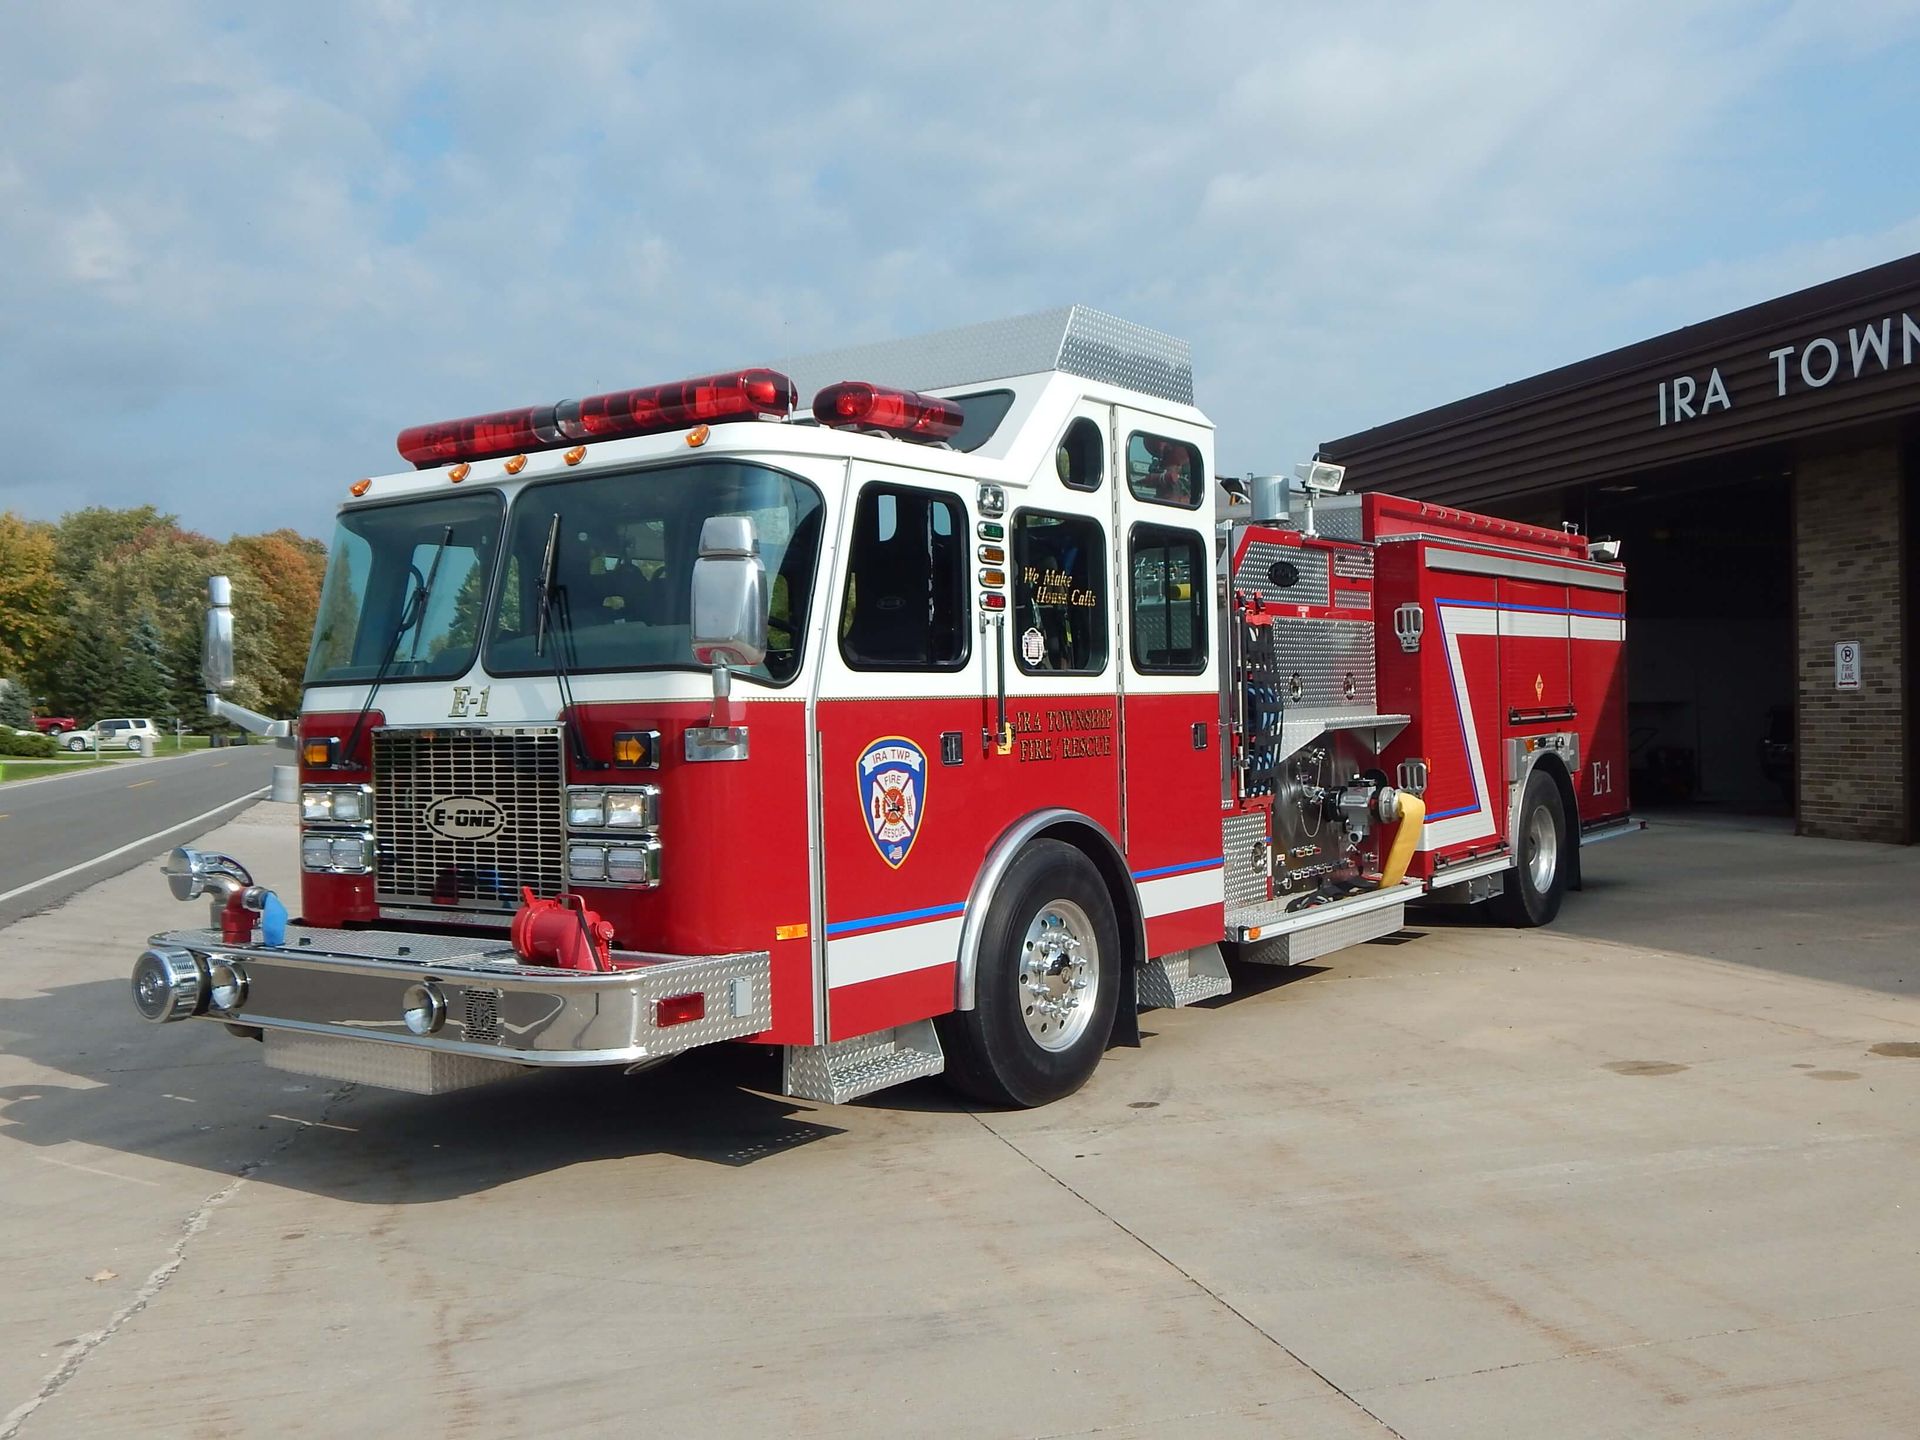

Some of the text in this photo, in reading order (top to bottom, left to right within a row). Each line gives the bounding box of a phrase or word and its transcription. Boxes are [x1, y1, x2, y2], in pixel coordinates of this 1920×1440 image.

[1658, 367, 1732, 427] IRA
[1024, 566, 1073, 587] We Make
[1036, 586, 1097, 607] House Calls
[448, 684, 491, 718] E-1
[1016, 708, 1113, 734] IRA TOWNSHIP
[872, 751, 888, 765] IRA
[1020, 738, 1052, 762] FIRE
[1062, 735, 1111, 759] RESCUE
[884, 774, 901, 786] FIRE
[1592, 759, 1612, 796] E-1
[433, 808, 496, 828] E-ONE
[883, 826, 906, 839] RESCUE
